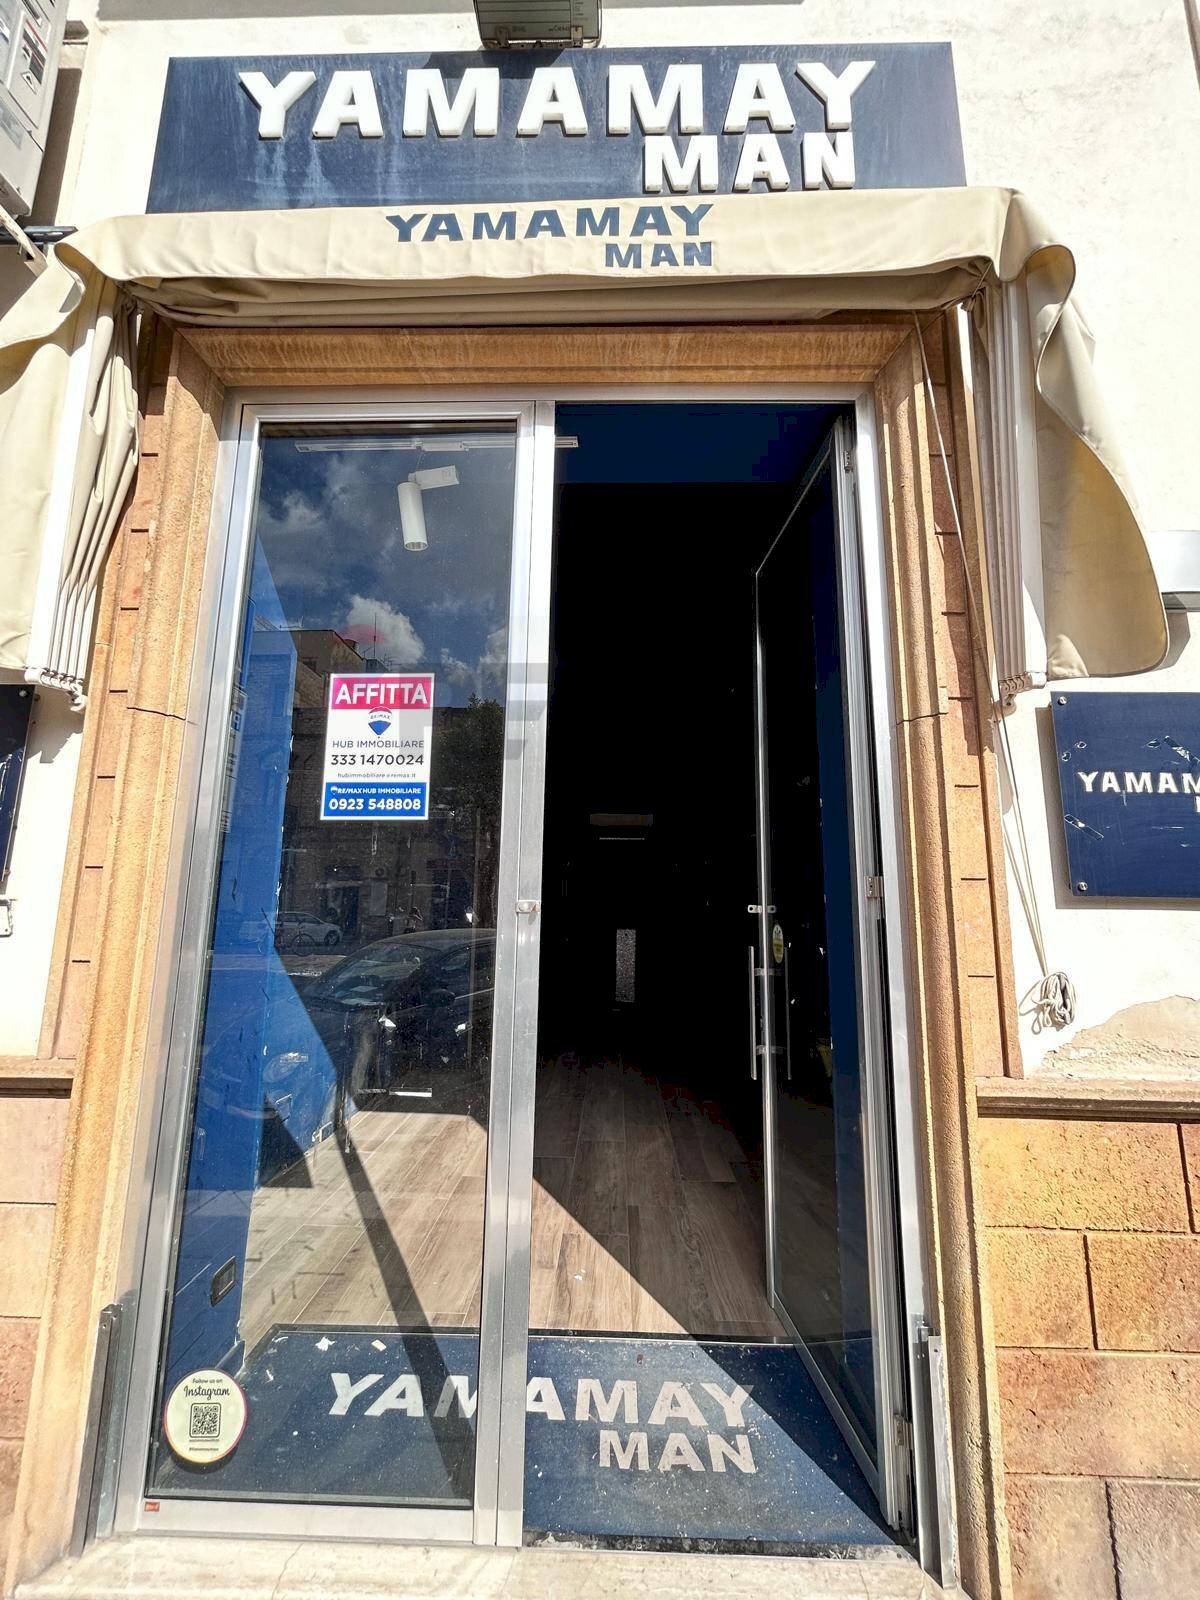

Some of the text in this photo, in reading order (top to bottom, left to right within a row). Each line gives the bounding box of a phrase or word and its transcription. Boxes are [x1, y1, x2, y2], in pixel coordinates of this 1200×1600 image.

[238, 59, 876, 138] YAMAMAY
[644, 131, 856, 192] MAN
[385, 204, 714, 242] YAMAMAY
[605, 241, 712, 269] MAN
[335, 683, 428, 705] AFFITTA
[332, 740, 425, 748] HUB IMMOBILIARE
[331, 754, 425, 766] 333 1470024
[363, 787, 377, 795] HUB
[378, 787, 422, 795] IMMOBILIARE
[328, 798, 421, 810] 0923 548808
[183, 1385, 231, 1401] Instagram
[598, 1429, 757, 1474] MAN
